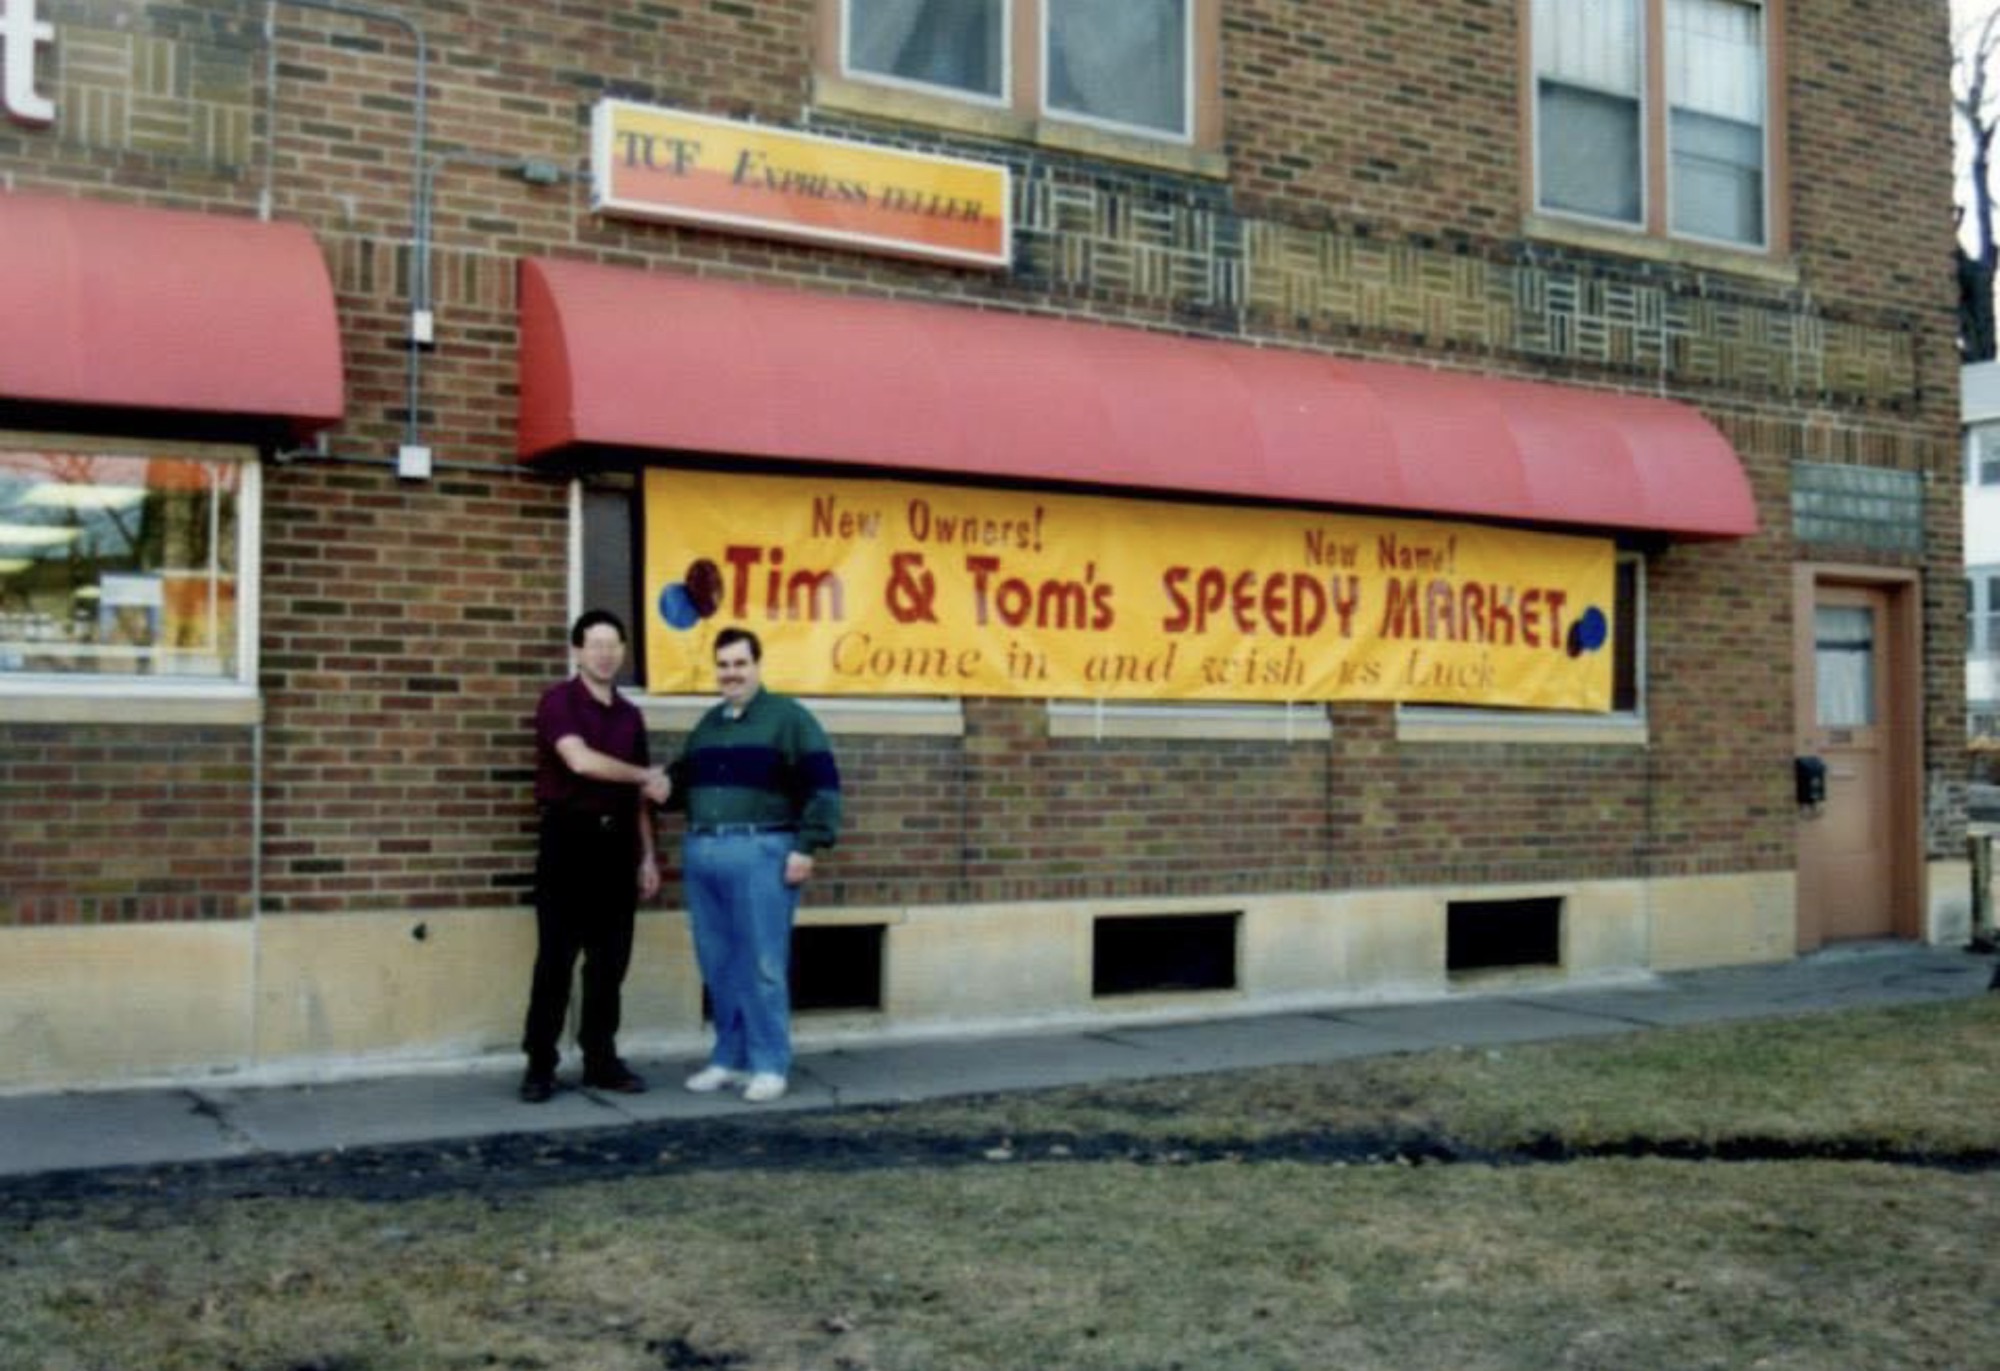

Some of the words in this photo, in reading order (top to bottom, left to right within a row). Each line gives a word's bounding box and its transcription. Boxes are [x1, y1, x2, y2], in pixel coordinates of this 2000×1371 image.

[616, 130, 701, 176] TCF
[811, 496, 881, 539] New
[908, 499, 1045, 551] Owners!
[1304, 529, 1358, 568] New
[1379, 534, 1458, 573] Name!
[725, 545, 844, 622] Tim
[886, 552, 937, 624] &
[966, 554, 1115, 631] Tom's
[1163, 566, 1359, 638] SPEEDY
[1379, 577, 1567, 649] MARKET
[831, 632, 982, 678] Come
[1007, 642, 1050, 679] in
[1084, 641, 1178, 684] and
[1202, 647, 1306, 684] wish
[1337, 657, 1382, 683] us
[1405, 648, 1496, 690] Luck
